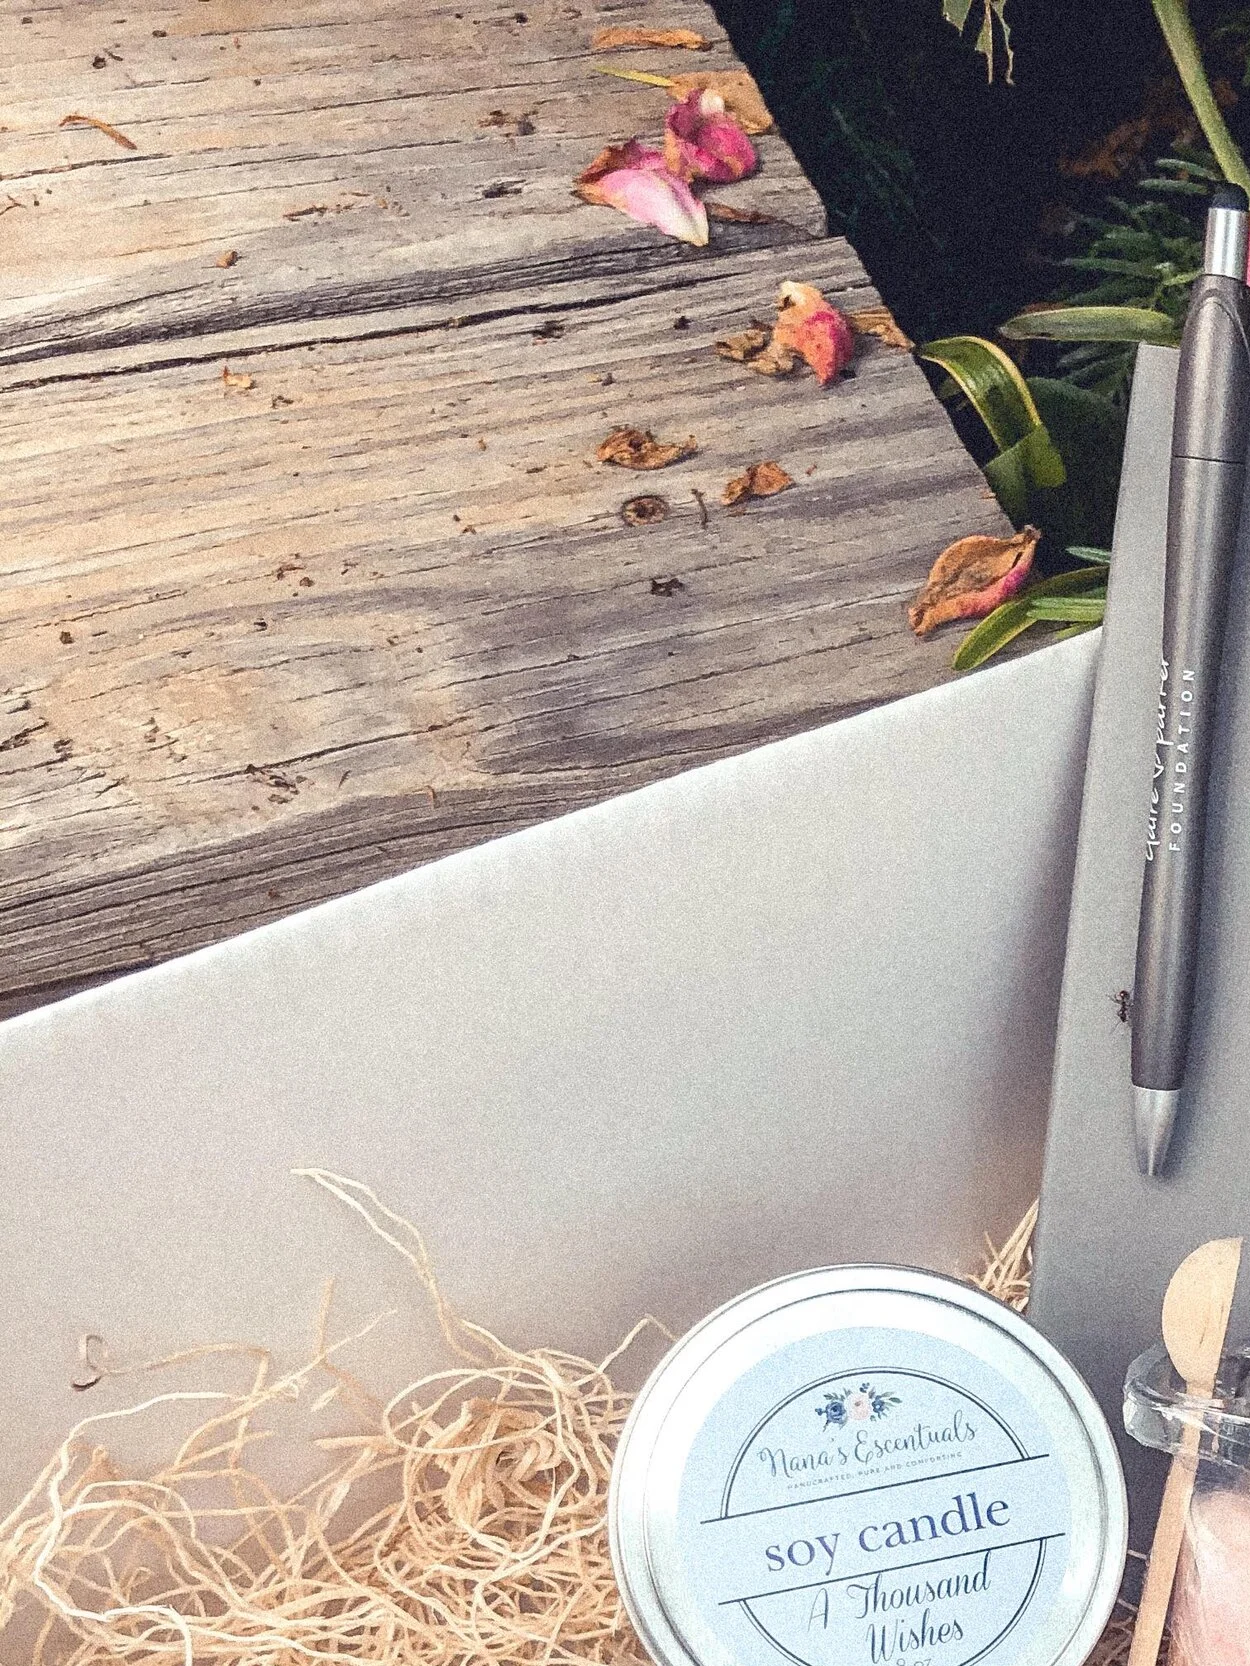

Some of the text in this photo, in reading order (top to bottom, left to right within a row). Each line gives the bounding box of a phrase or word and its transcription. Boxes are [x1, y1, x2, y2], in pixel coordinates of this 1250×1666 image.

[1168, 669, 1196, 852] FOUNDATION
[756, 1409, 978, 1478] Nana's Escentuals
[765, 1491, 1011, 1576] soy candle
[807, 1550, 992, 1632] A Thousand
[866, 1607, 964, 1664] Wishes
